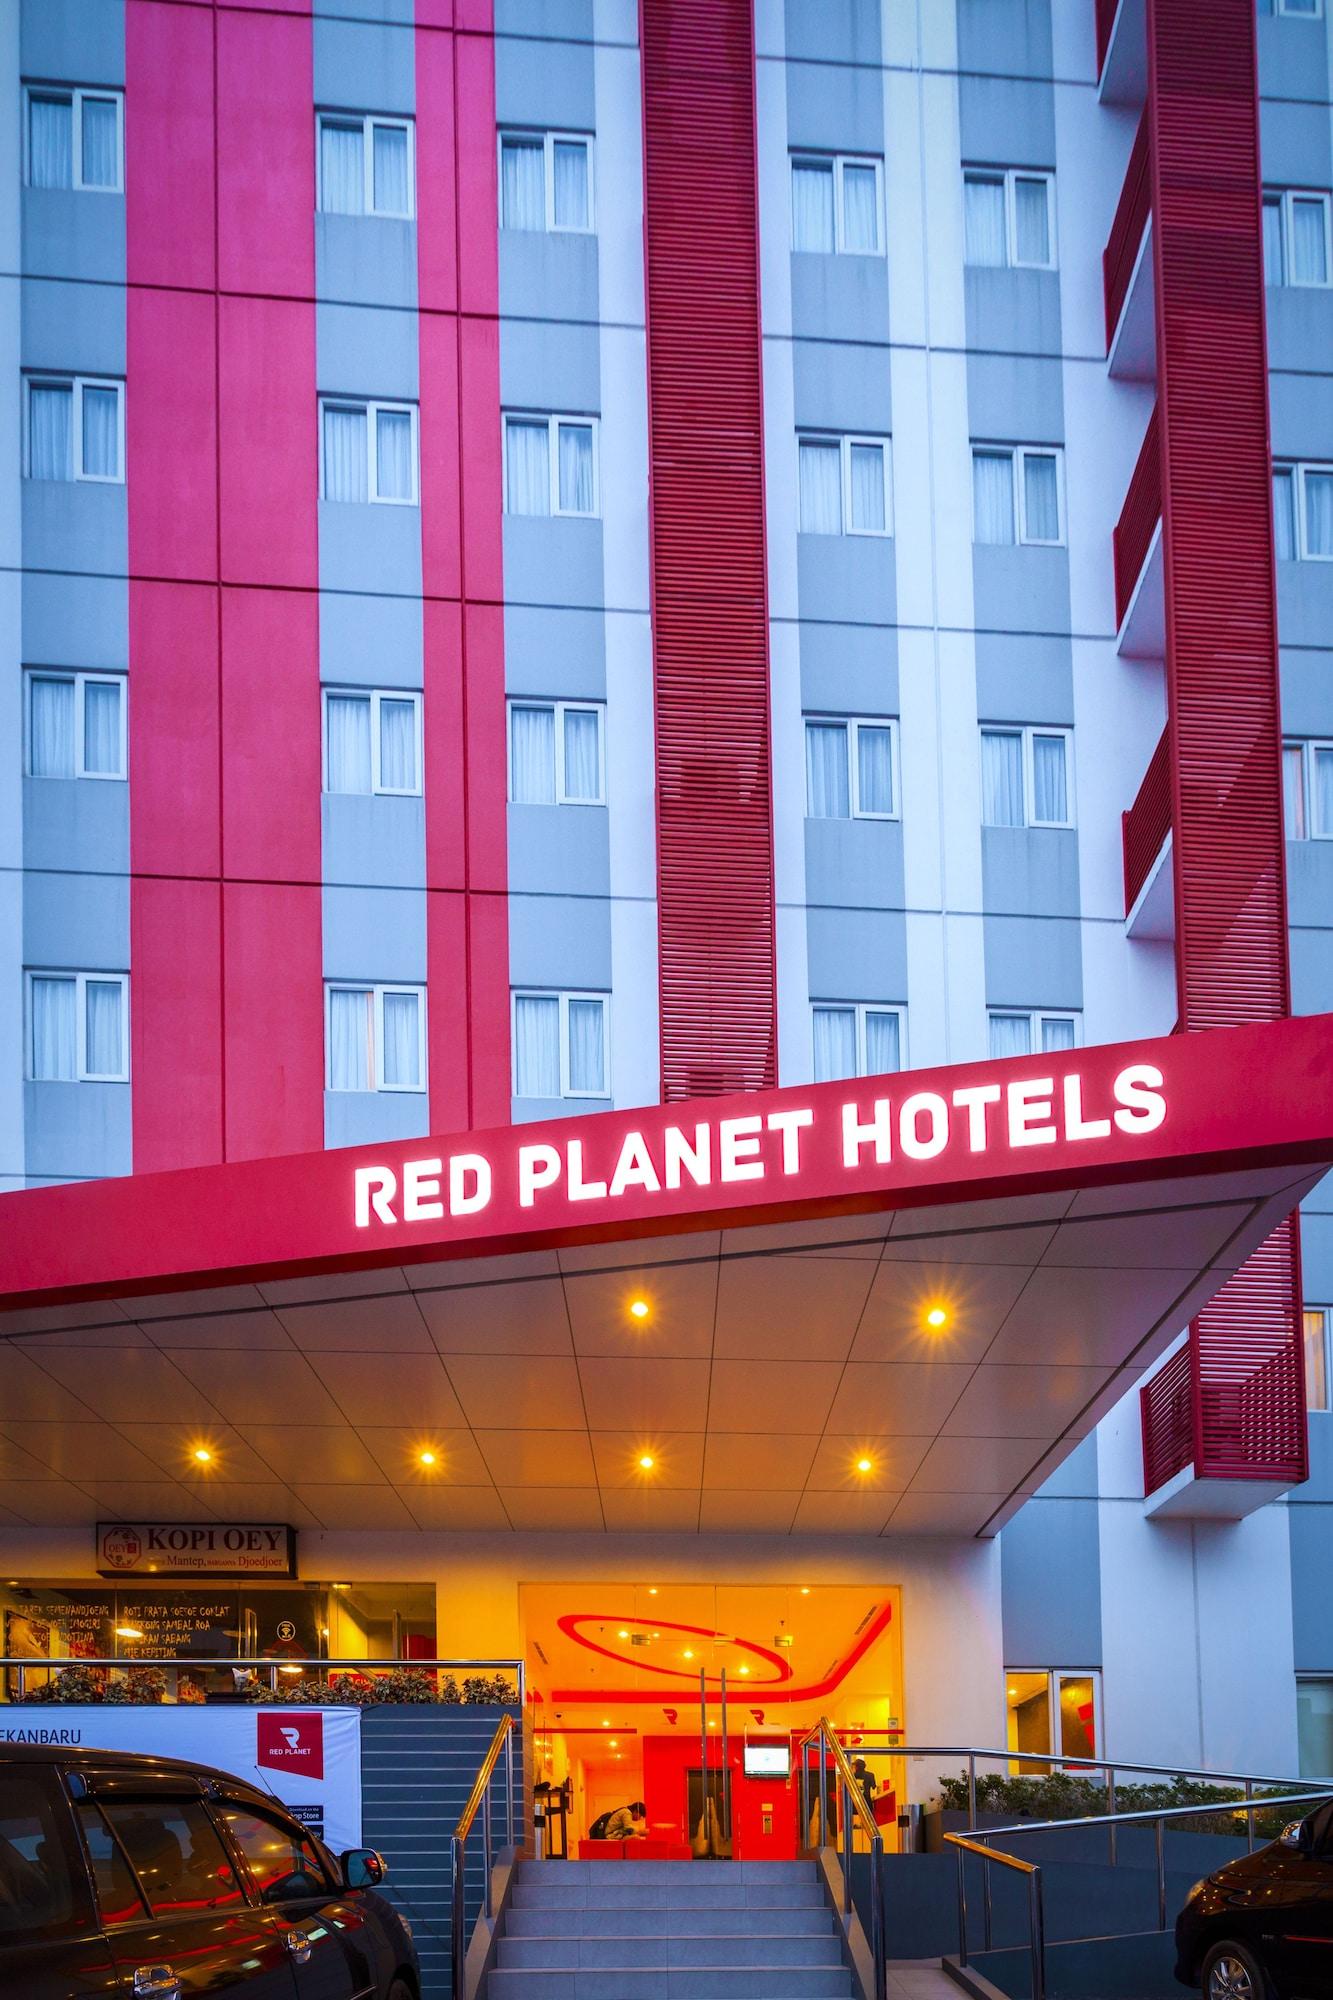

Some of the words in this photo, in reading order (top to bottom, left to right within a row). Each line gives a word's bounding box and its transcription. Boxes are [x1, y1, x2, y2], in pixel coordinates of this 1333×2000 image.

[355, 1153, 492, 1228] RED
[518, 1109, 814, 1208] PLANET
[842, 1064, 1167, 1168] HOTELS
[147, 1528, 217, 1550] KOPI
[223, 1528, 282, 1551] OEY
[238, 1556, 282, 1568] Djoedjoer
[123, 1606, 141, 1617] ROTI
[144, 1606, 168, 1617] PRATA
[200, 1606, 230, 1617] COKLAT
[195, 1620, 211, 1630] ROA
[303, 1812, 320, 1820] Store
